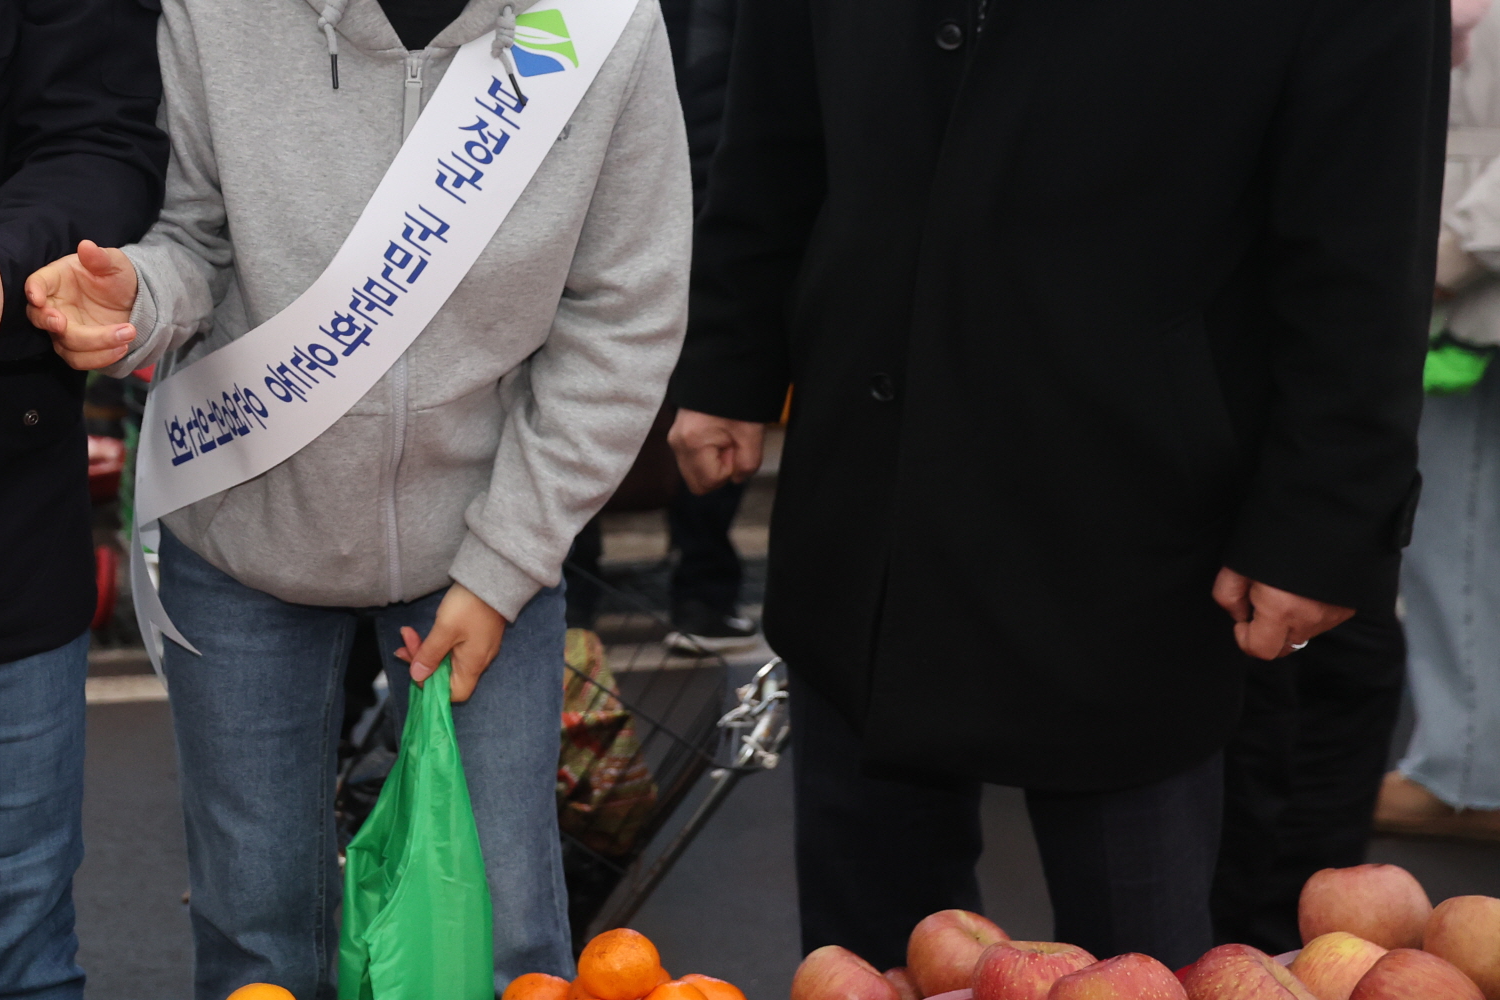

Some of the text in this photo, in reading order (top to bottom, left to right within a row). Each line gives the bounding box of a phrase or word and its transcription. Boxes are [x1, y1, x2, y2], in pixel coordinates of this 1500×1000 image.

[165, 75, 528, 467] 보성군 군민문화운동 운영위원회
